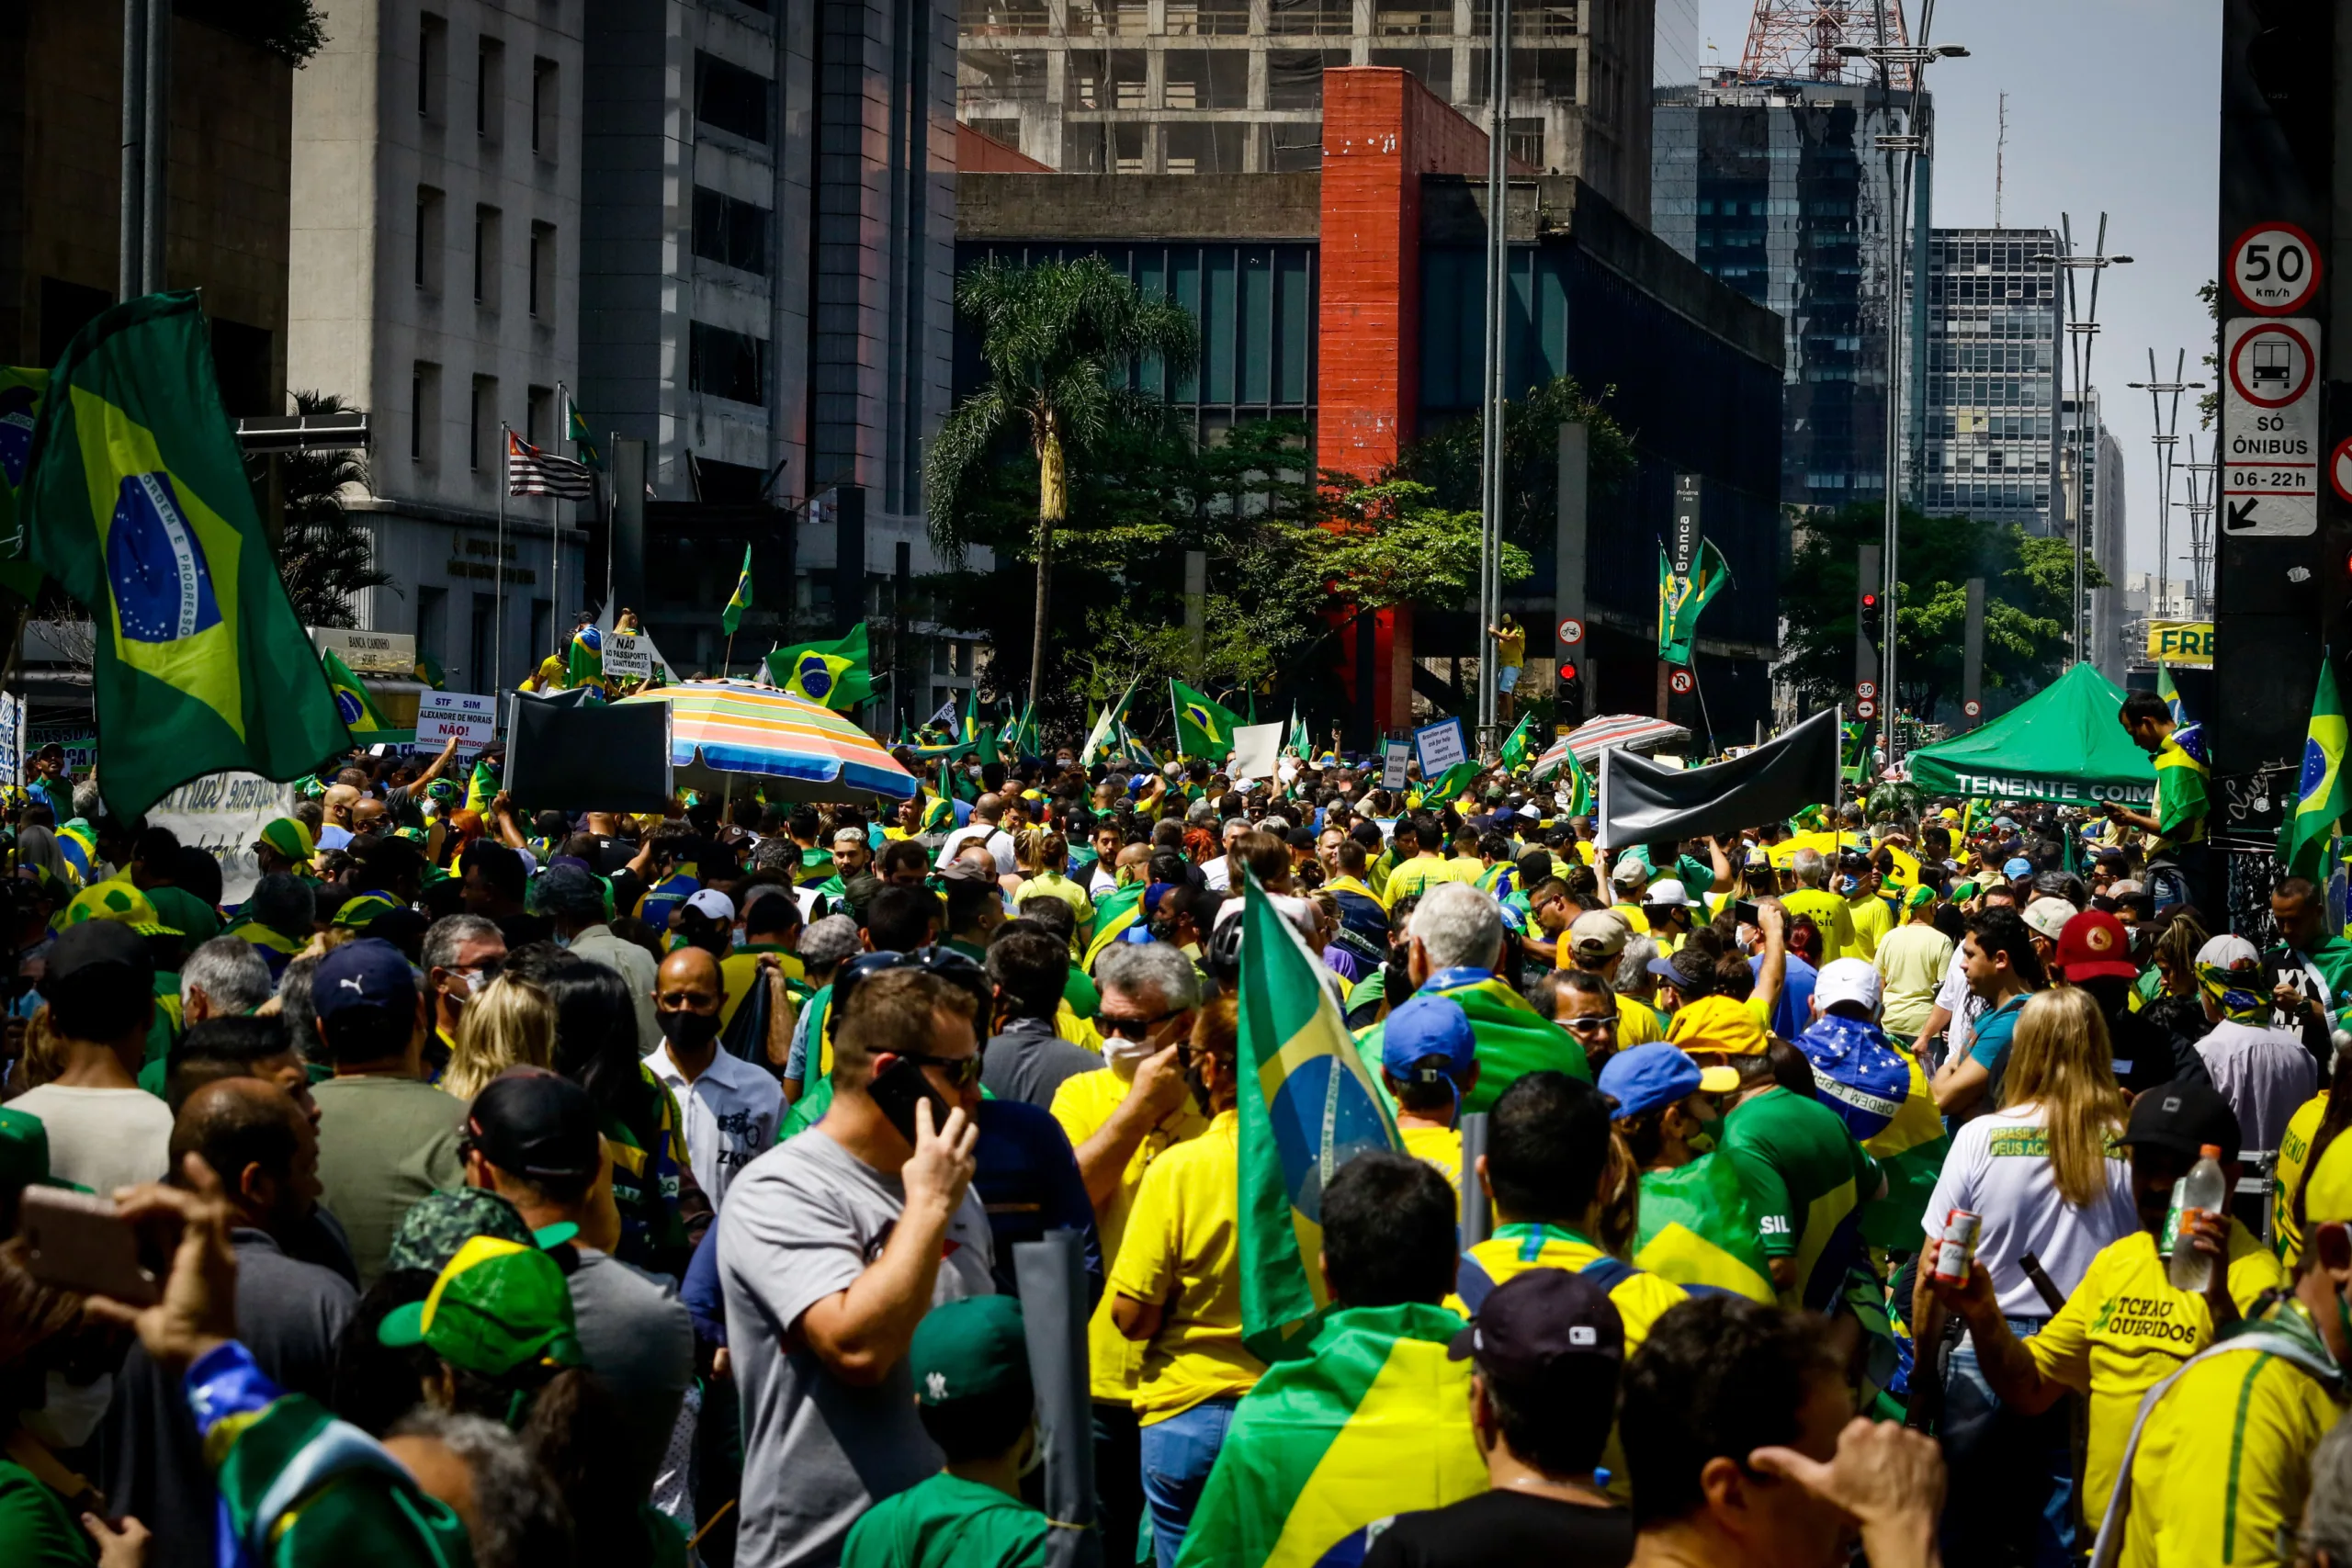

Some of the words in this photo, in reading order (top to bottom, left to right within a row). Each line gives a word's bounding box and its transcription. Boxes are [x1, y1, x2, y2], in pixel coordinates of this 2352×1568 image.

[2245, 244, 2304, 283] 50
[2256, 288, 2290, 298] km/h
[2256, 412, 2284, 432] SÓ
[2233, 434, 2308, 455] ÔNIBUS
[1676, 515, 1690, 571] Branca
[142, 474, 176, 526] ORDEM
[174, 535, 184, 545] E
[179, 554, 197, 637] PROGRESSO
[348, 636, 367, 648] BANCA
[613, 649, 648, 660] PASSAPORTE
[1860, 684, 1873, 694] 50
[435, 697, 452, 707] STF
[462, 700, 481, 710] SIM
[419, 710, 457, 722] ALEXANDRE
[457, 714, 466, 722] DE
[466, 715, 492, 725] MORAIS
[438, 722, 470, 737] NÃO!
[1955, 773, 2078, 799] TENENTE
[1849, 1088, 1895, 1115] ORDEM
[1991, 1129, 2033, 1141] BRASIL
[2118, 1296, 2174, 1318] TCHAU
[2109, 1316, 2197, 1344] QUERIDOS
